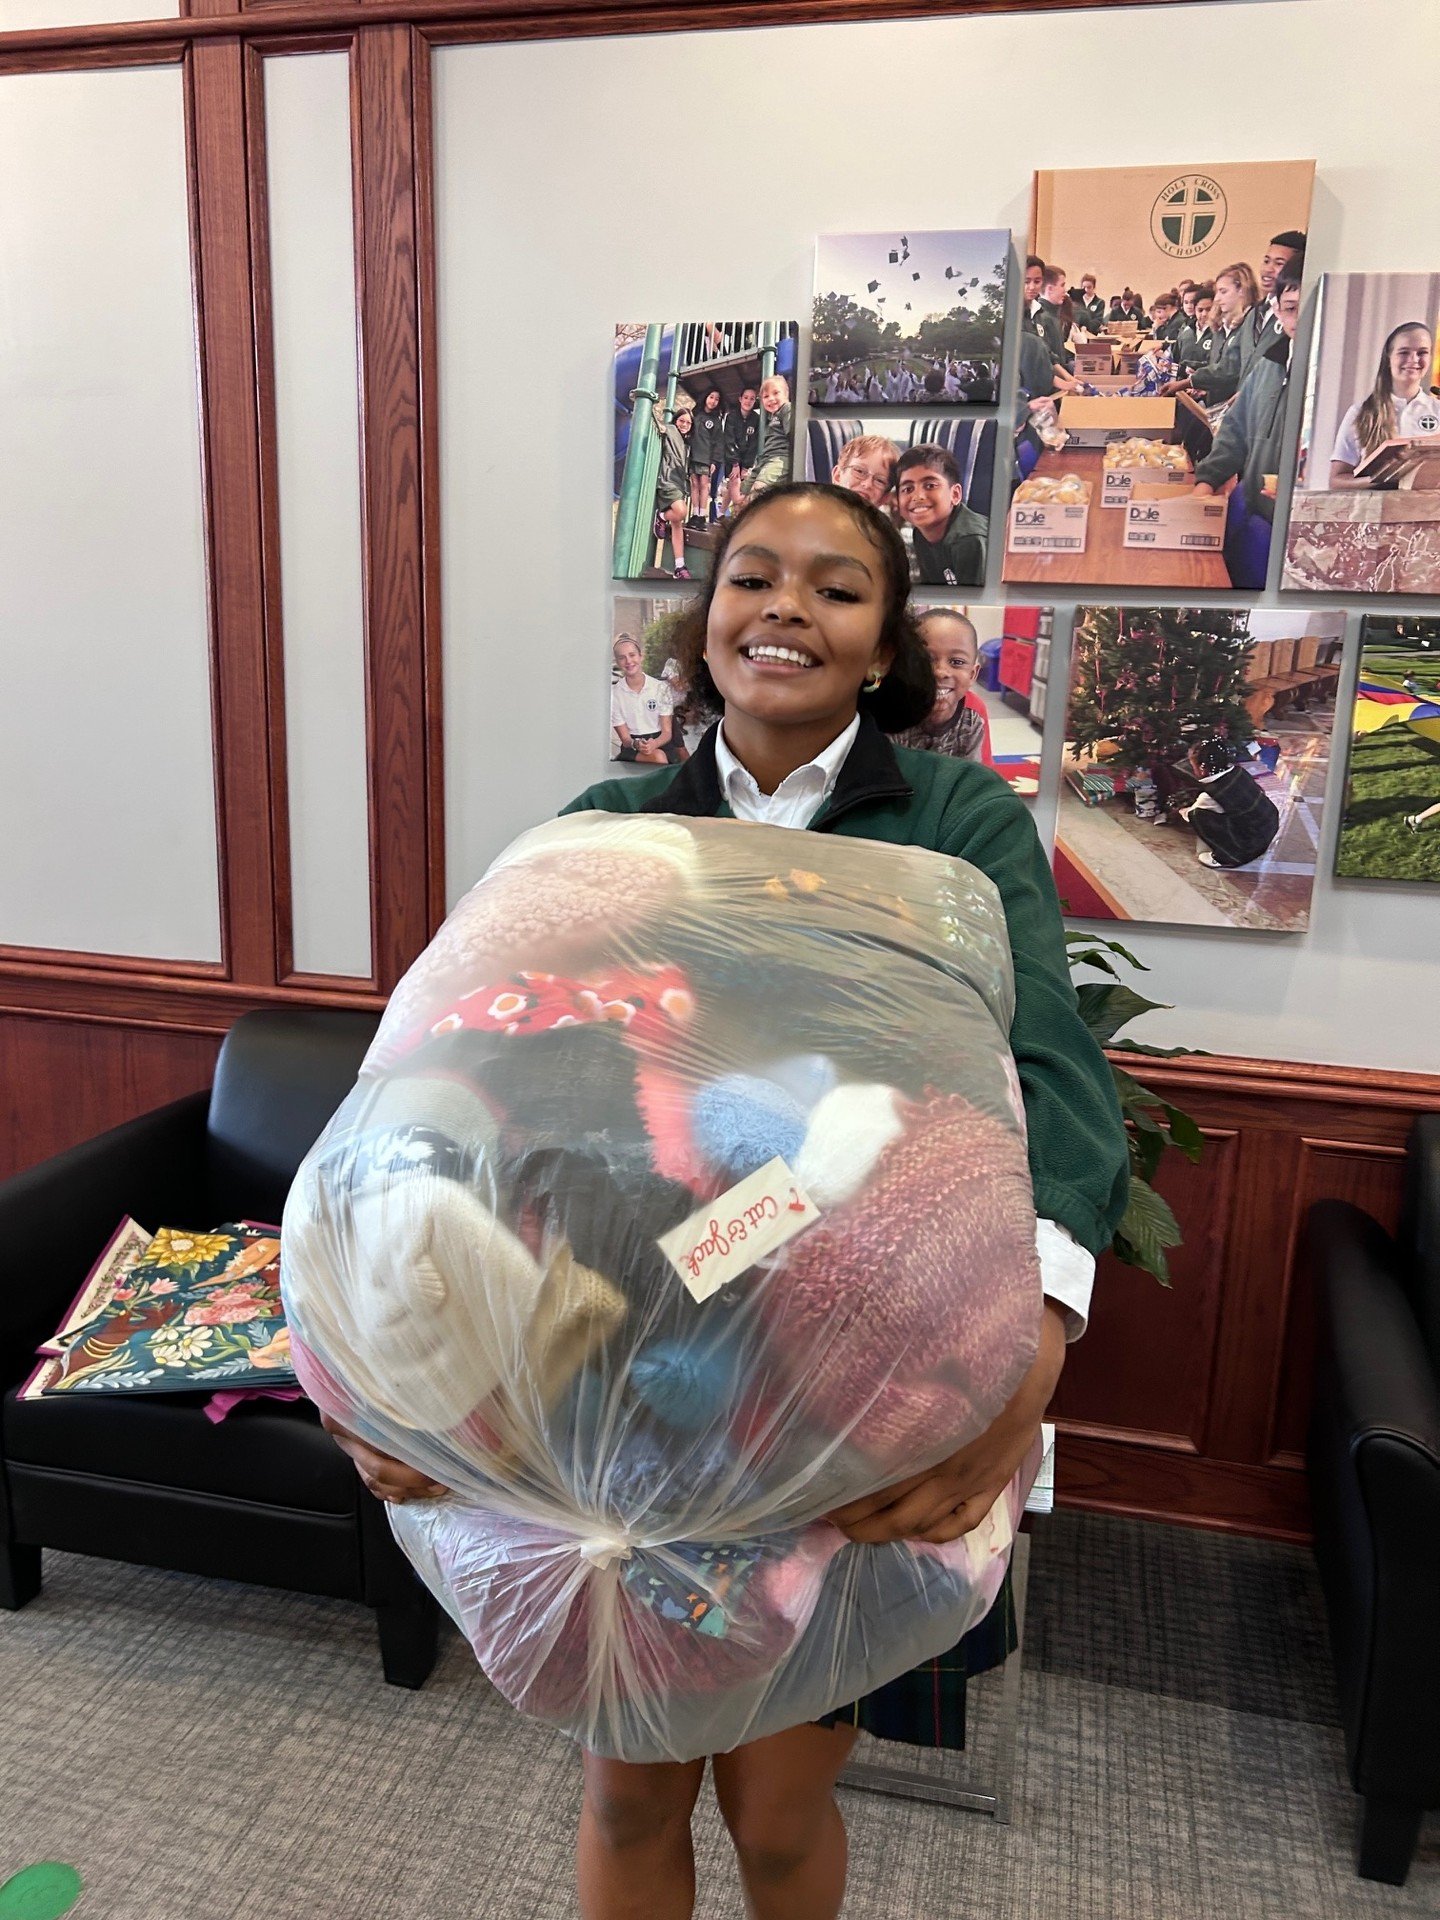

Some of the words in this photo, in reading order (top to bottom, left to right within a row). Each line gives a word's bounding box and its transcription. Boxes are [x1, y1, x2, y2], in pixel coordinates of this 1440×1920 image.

[1161, 180, 1186, 201] HOLY
[1194, 178, 1220, 200] CROSS
[1163, 241, 1208, 256] SCHOOL
[1106, 474, 1132, 486] Dole
[1015, 510, 1045, 523] Dole
[1130, 507, 1160, 520] Dole
[743, 1195, 778, 1229] Cat
[727, 1219, 748, 1243] &
[680, 1219, 730, 1277] Jack
